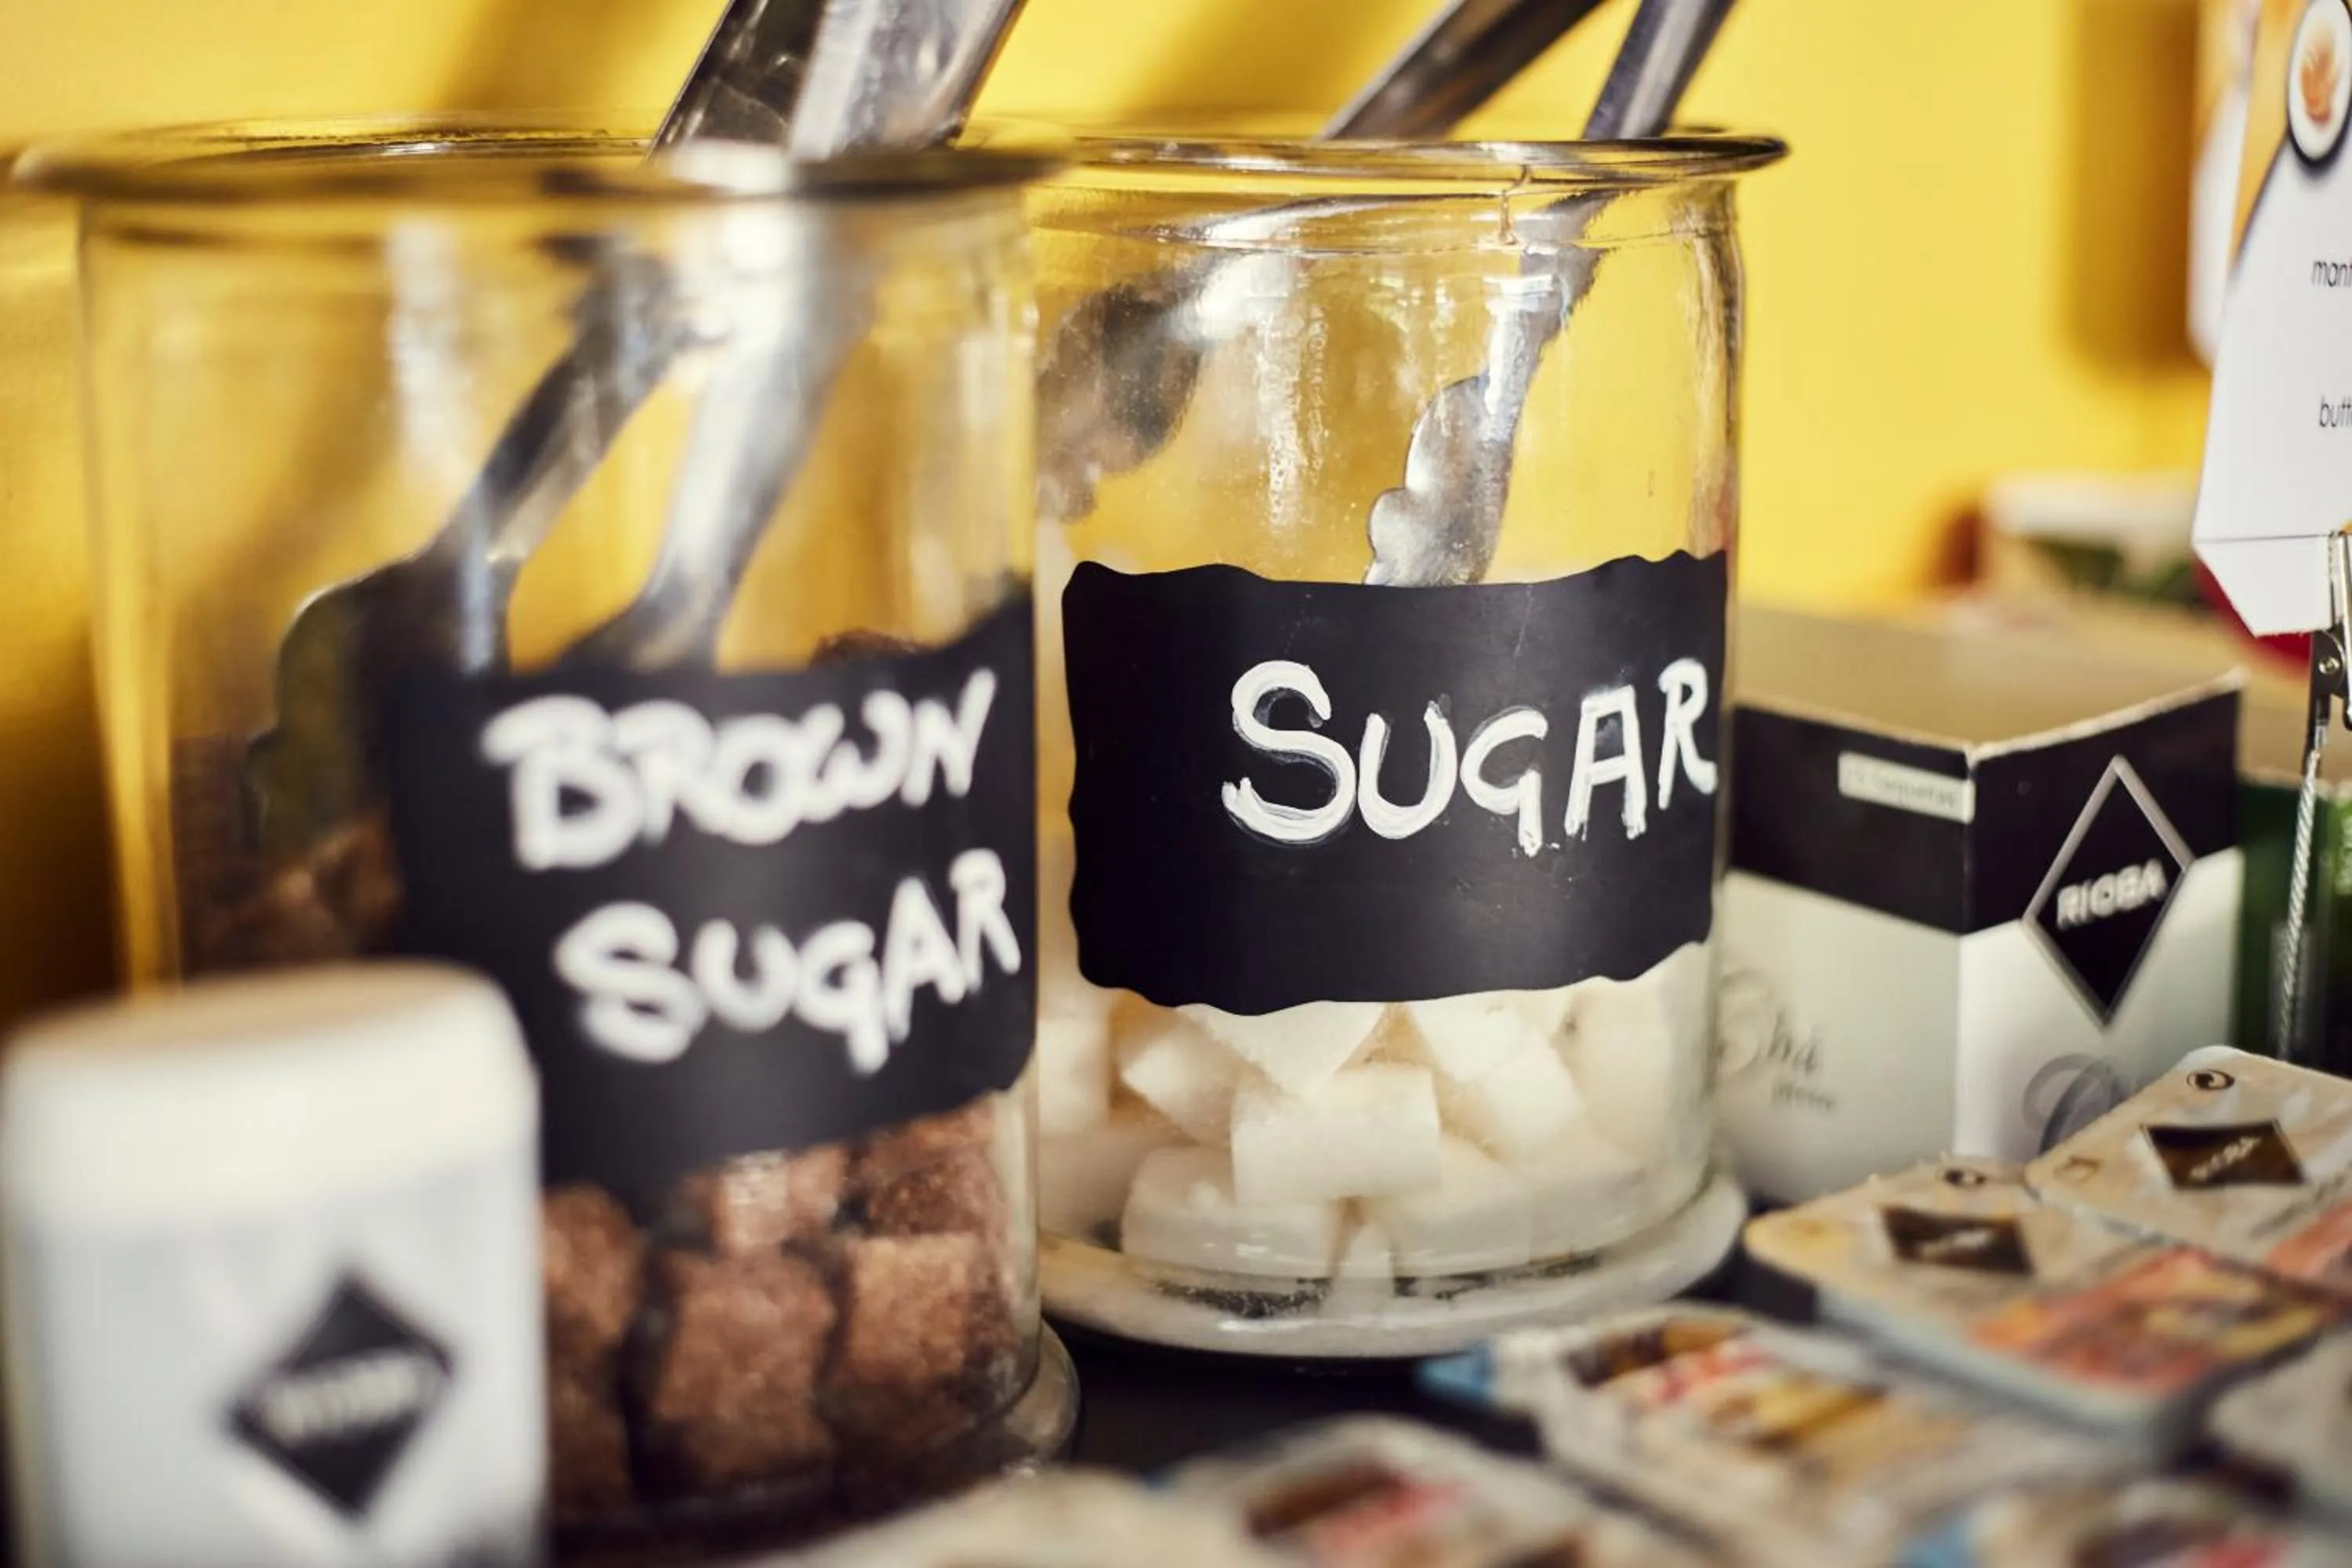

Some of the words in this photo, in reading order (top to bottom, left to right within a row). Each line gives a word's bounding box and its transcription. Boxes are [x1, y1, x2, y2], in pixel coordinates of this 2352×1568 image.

[482, 669, 997, 869] BROWN
[1221, 657, 1719, 858] SUGAR
[555, 848, 1022, 1074] SUGAR
[2056, 858, 2168, 927] RIOBA
